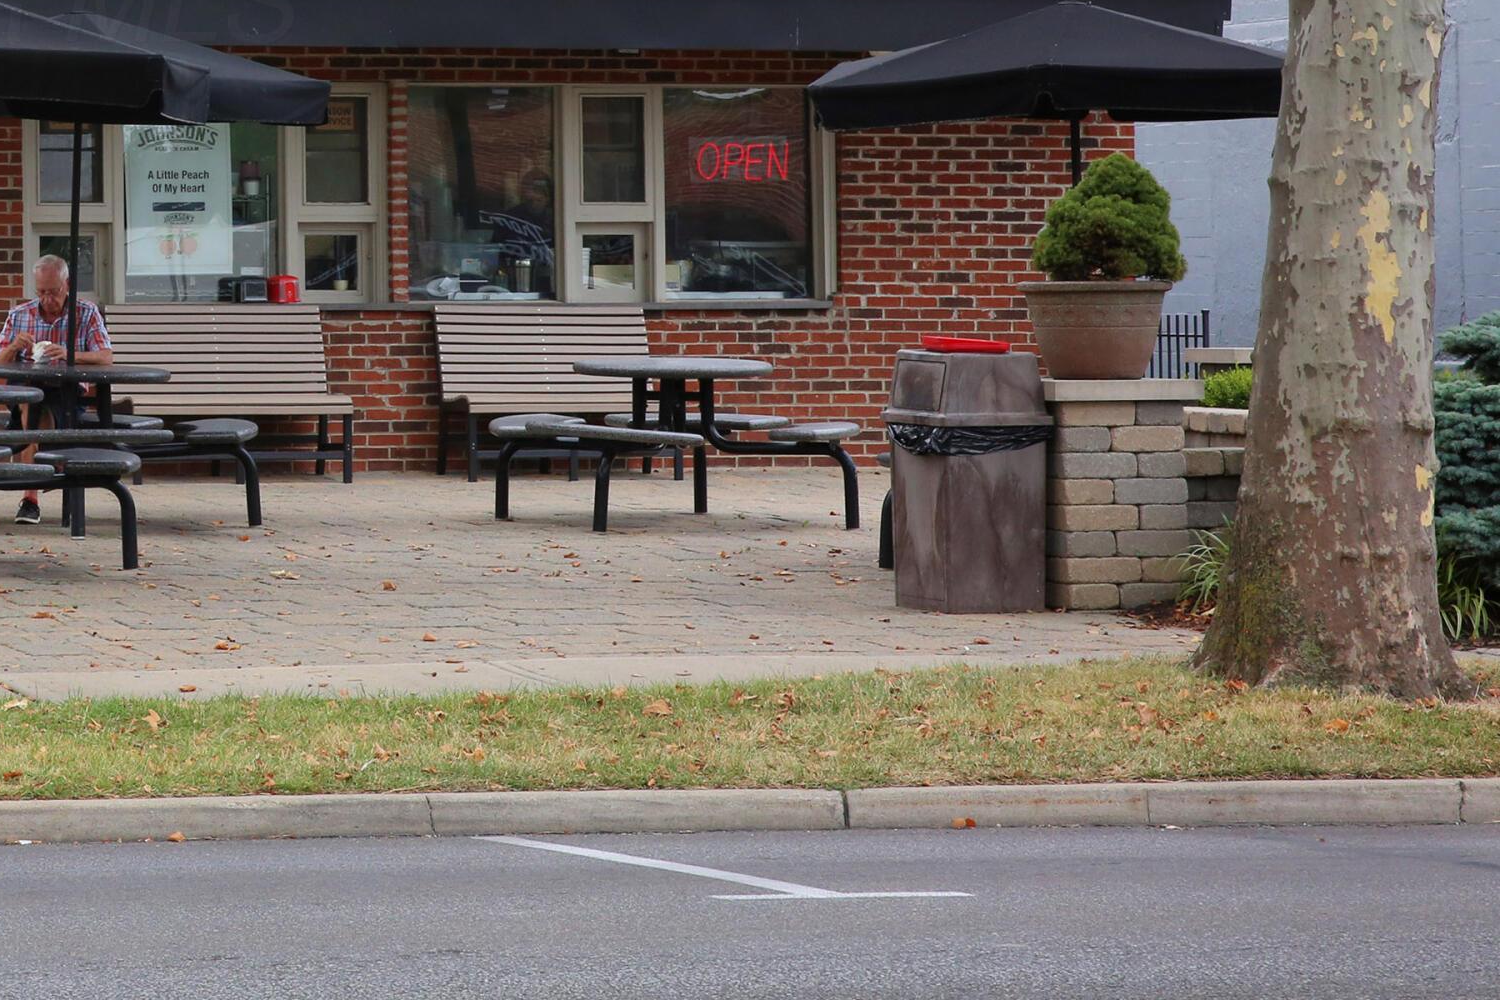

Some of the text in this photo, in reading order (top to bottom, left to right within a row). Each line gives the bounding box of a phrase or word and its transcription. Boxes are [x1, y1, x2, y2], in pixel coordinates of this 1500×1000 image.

[696, 142, 789, 182] OPEN
[147, 170, 210, 180] A Little Peach
[152, 183, 205, 195] Of My Heart
